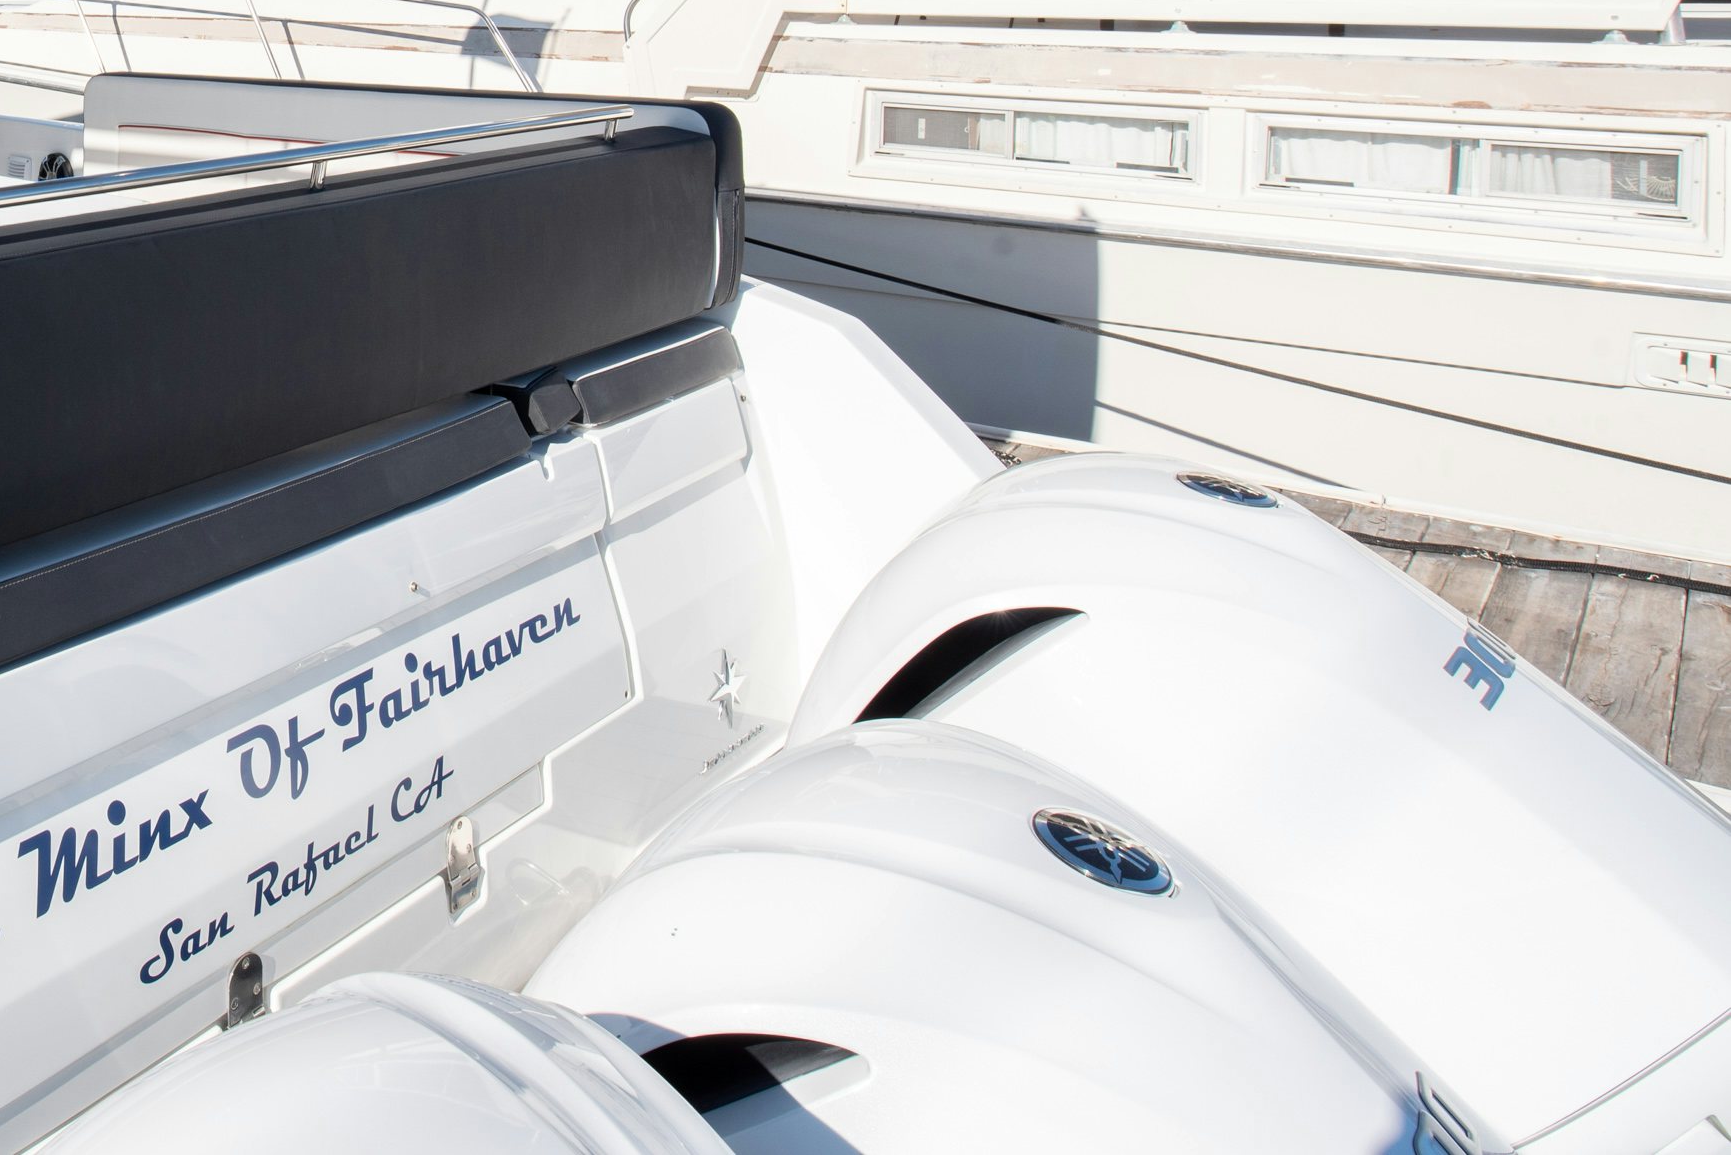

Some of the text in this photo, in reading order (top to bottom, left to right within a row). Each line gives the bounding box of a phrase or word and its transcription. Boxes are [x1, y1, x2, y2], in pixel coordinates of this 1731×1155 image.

[18, 788, 213, 918] Minx
[227, 715, 325, 800] Of
[329, 595, 581, 751] Fairhaven
[140, 754, 454, 985] San Rafael CA
